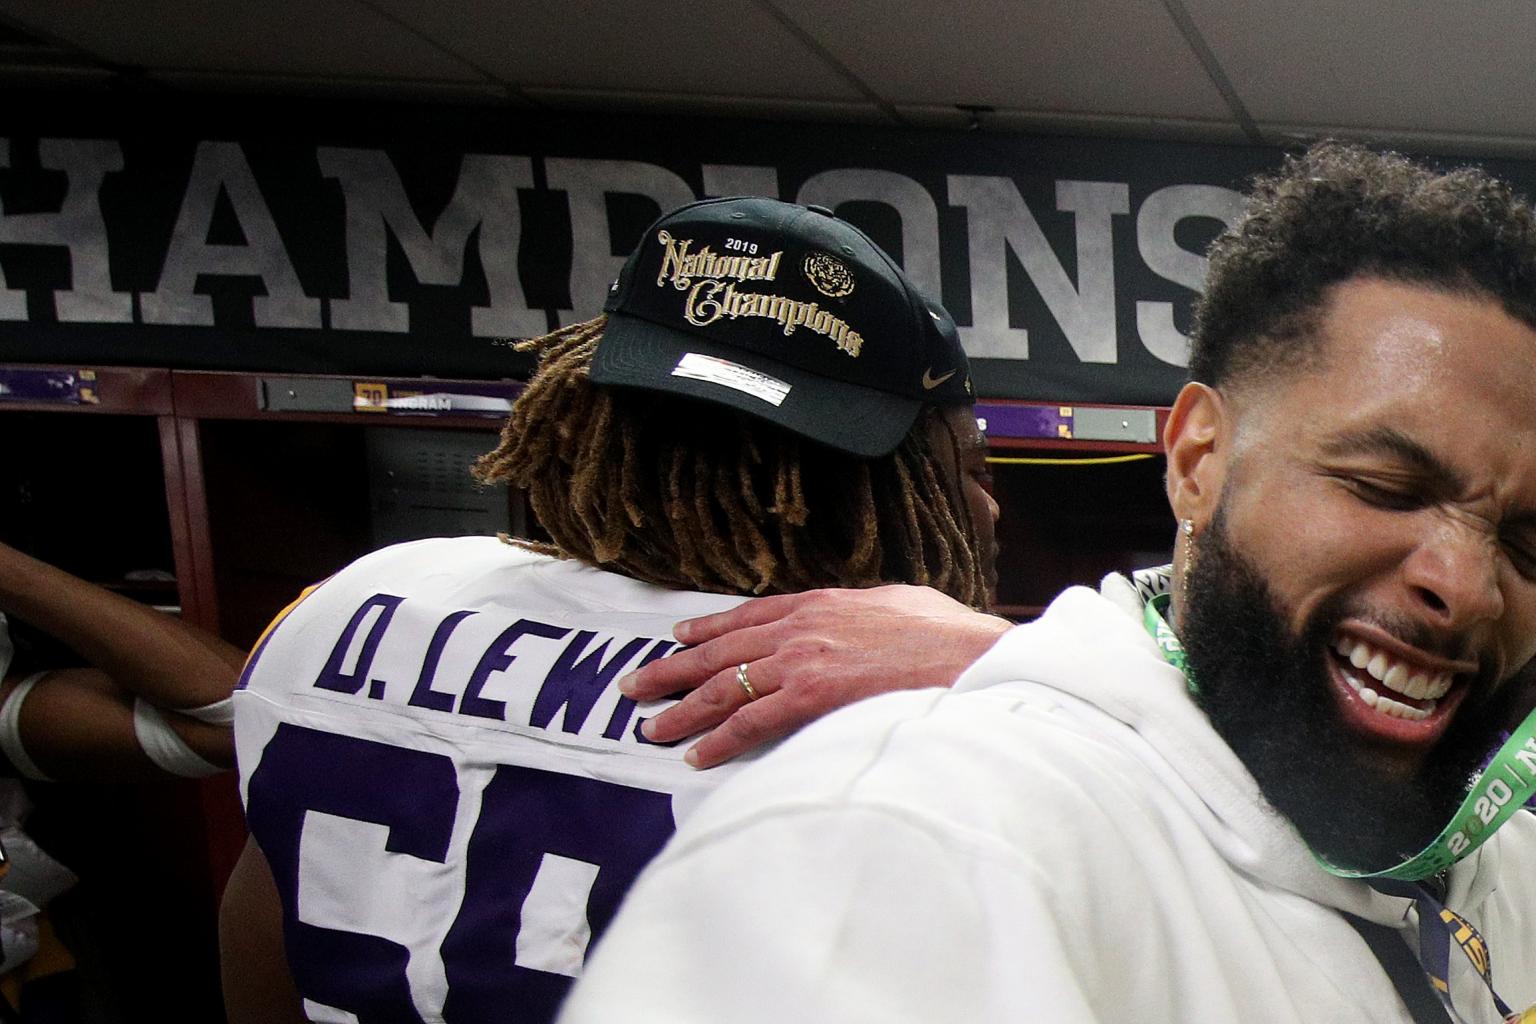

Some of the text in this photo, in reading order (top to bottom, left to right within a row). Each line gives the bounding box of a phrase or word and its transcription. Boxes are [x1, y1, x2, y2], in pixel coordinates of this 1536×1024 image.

[657, 229, 784, 291] National
[725, 237, 759, 255] 2019
[683, 279, 865, 358] Champions
[313, 593, 407, 701] D.
